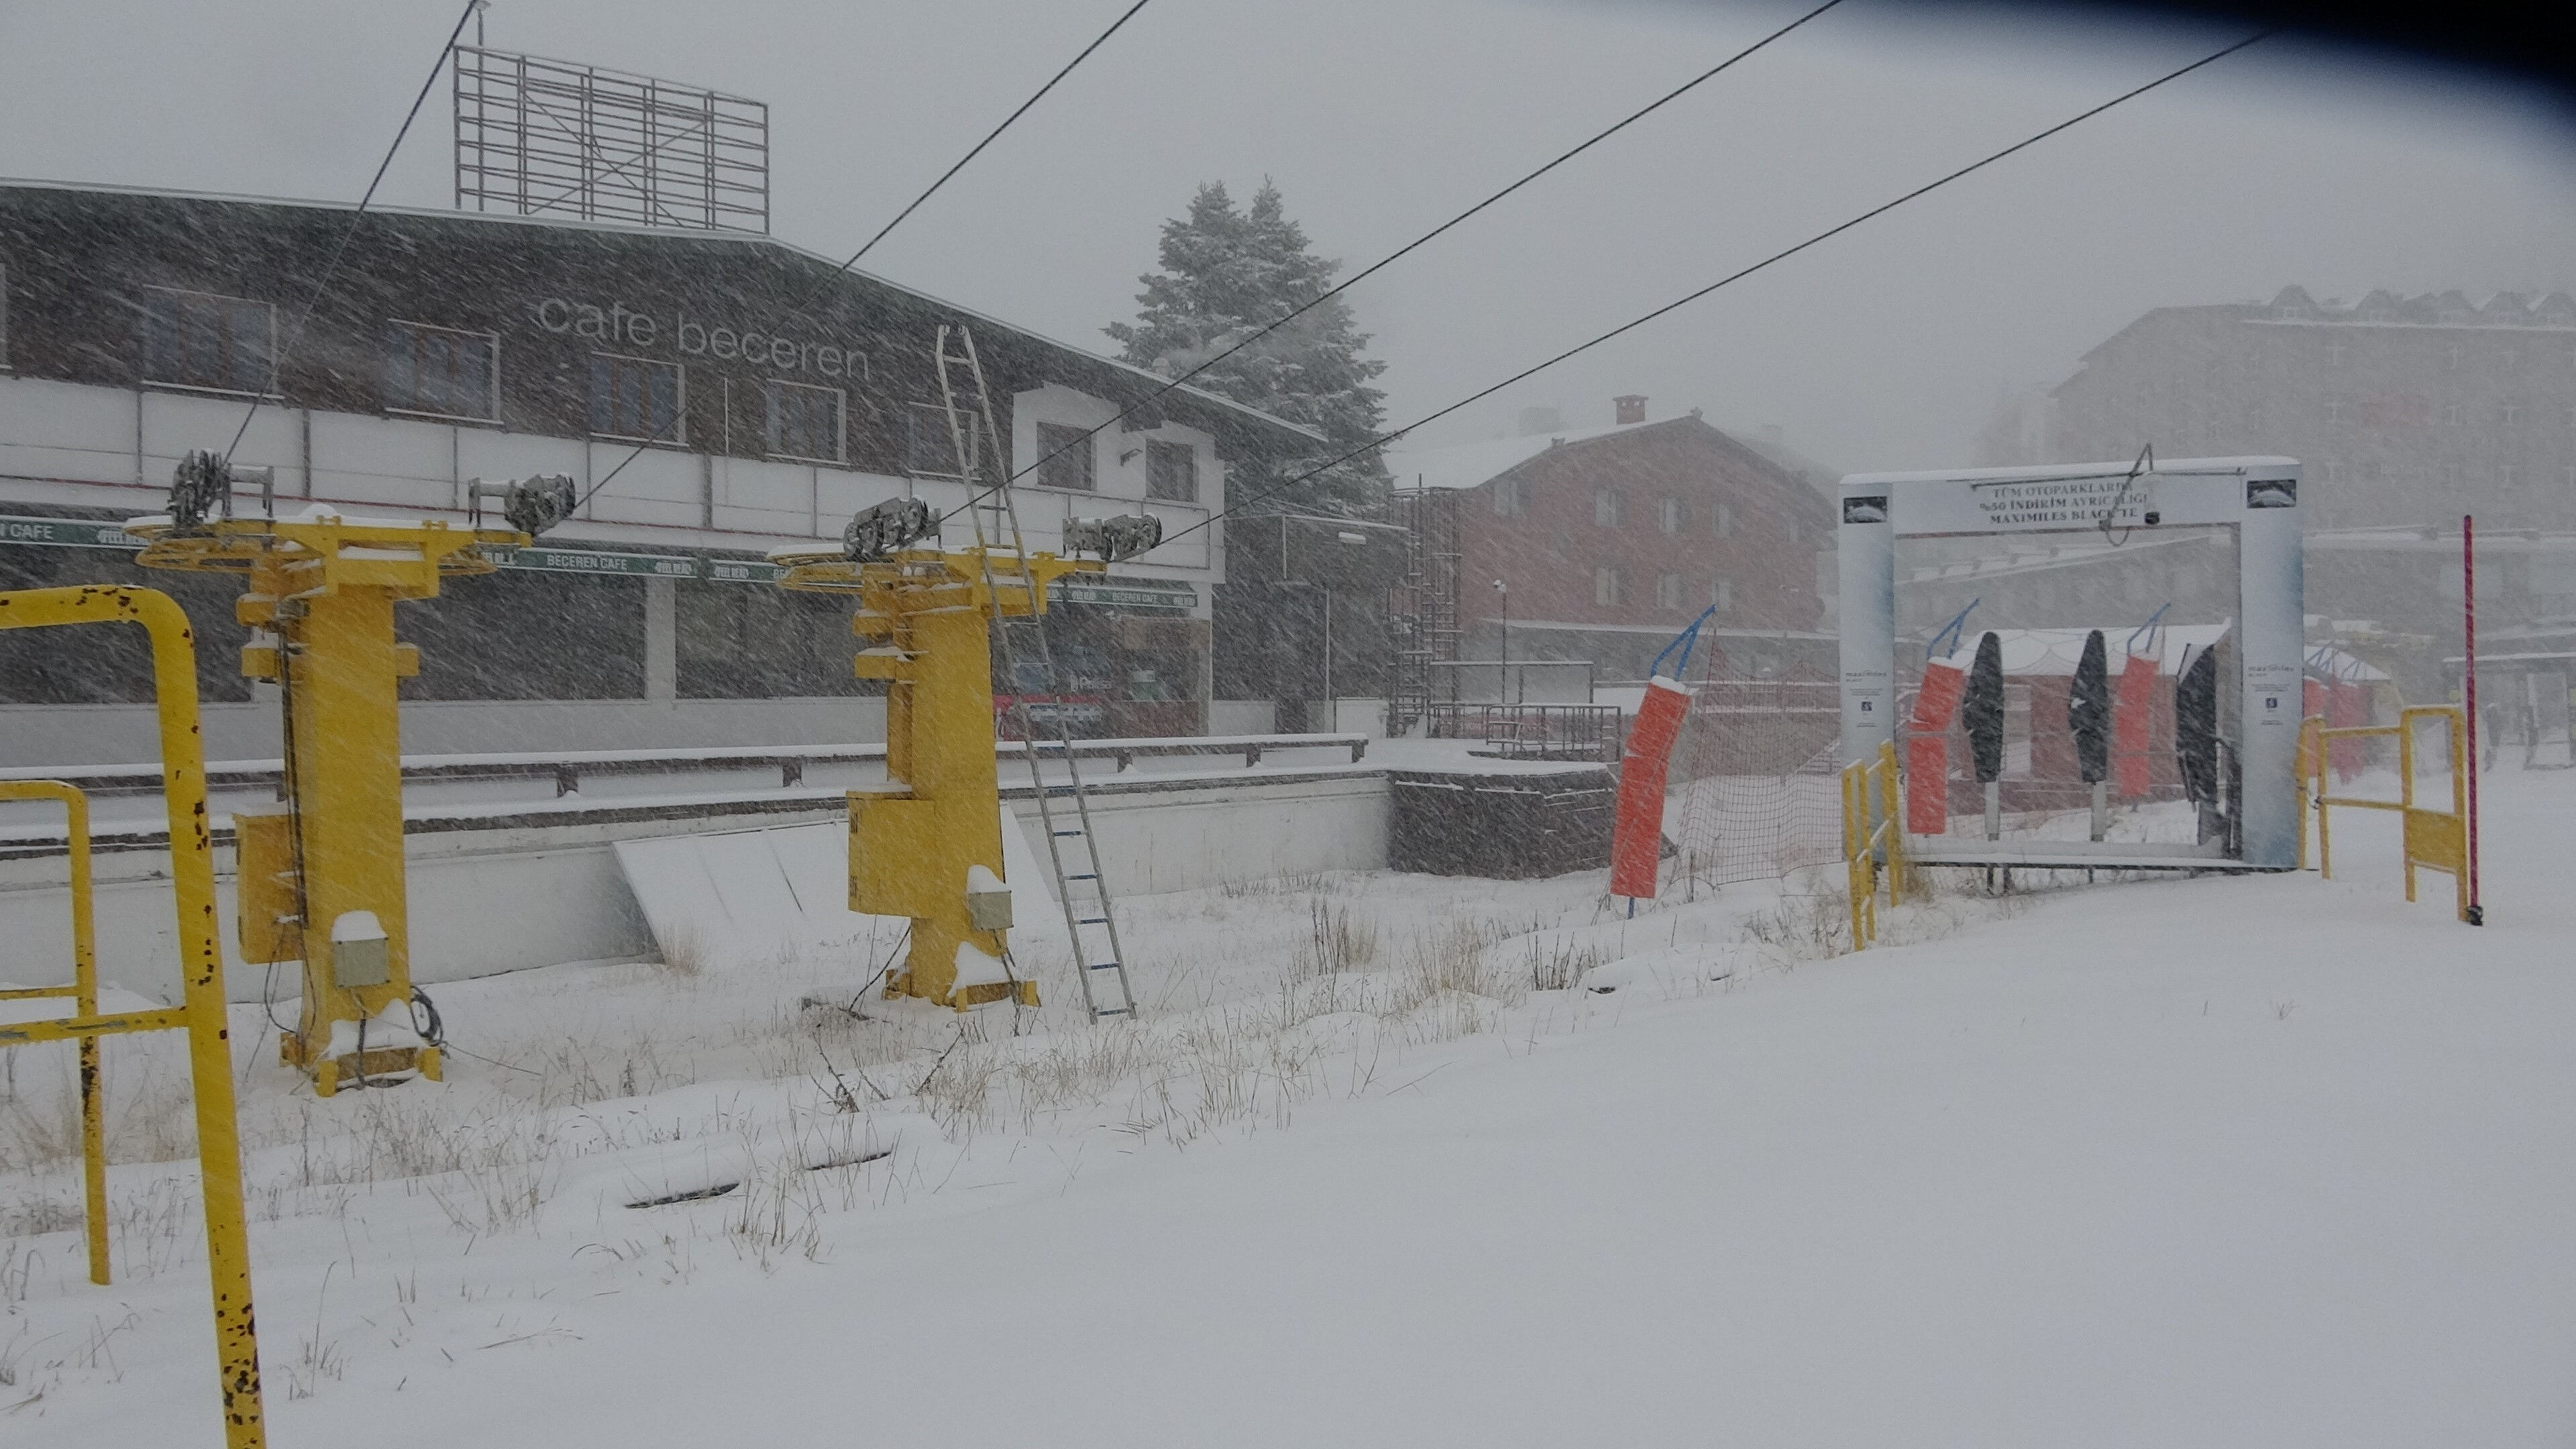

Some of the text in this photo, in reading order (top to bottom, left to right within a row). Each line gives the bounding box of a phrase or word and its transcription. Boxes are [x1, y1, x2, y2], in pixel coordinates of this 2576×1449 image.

[539, 298, 870, 380] cafe beceren
[1993, 486, 2022, 498] TÜM
[9, 523, 54, 539] CAFE
[546, 554, 628, 570] BECEREN CAFE
